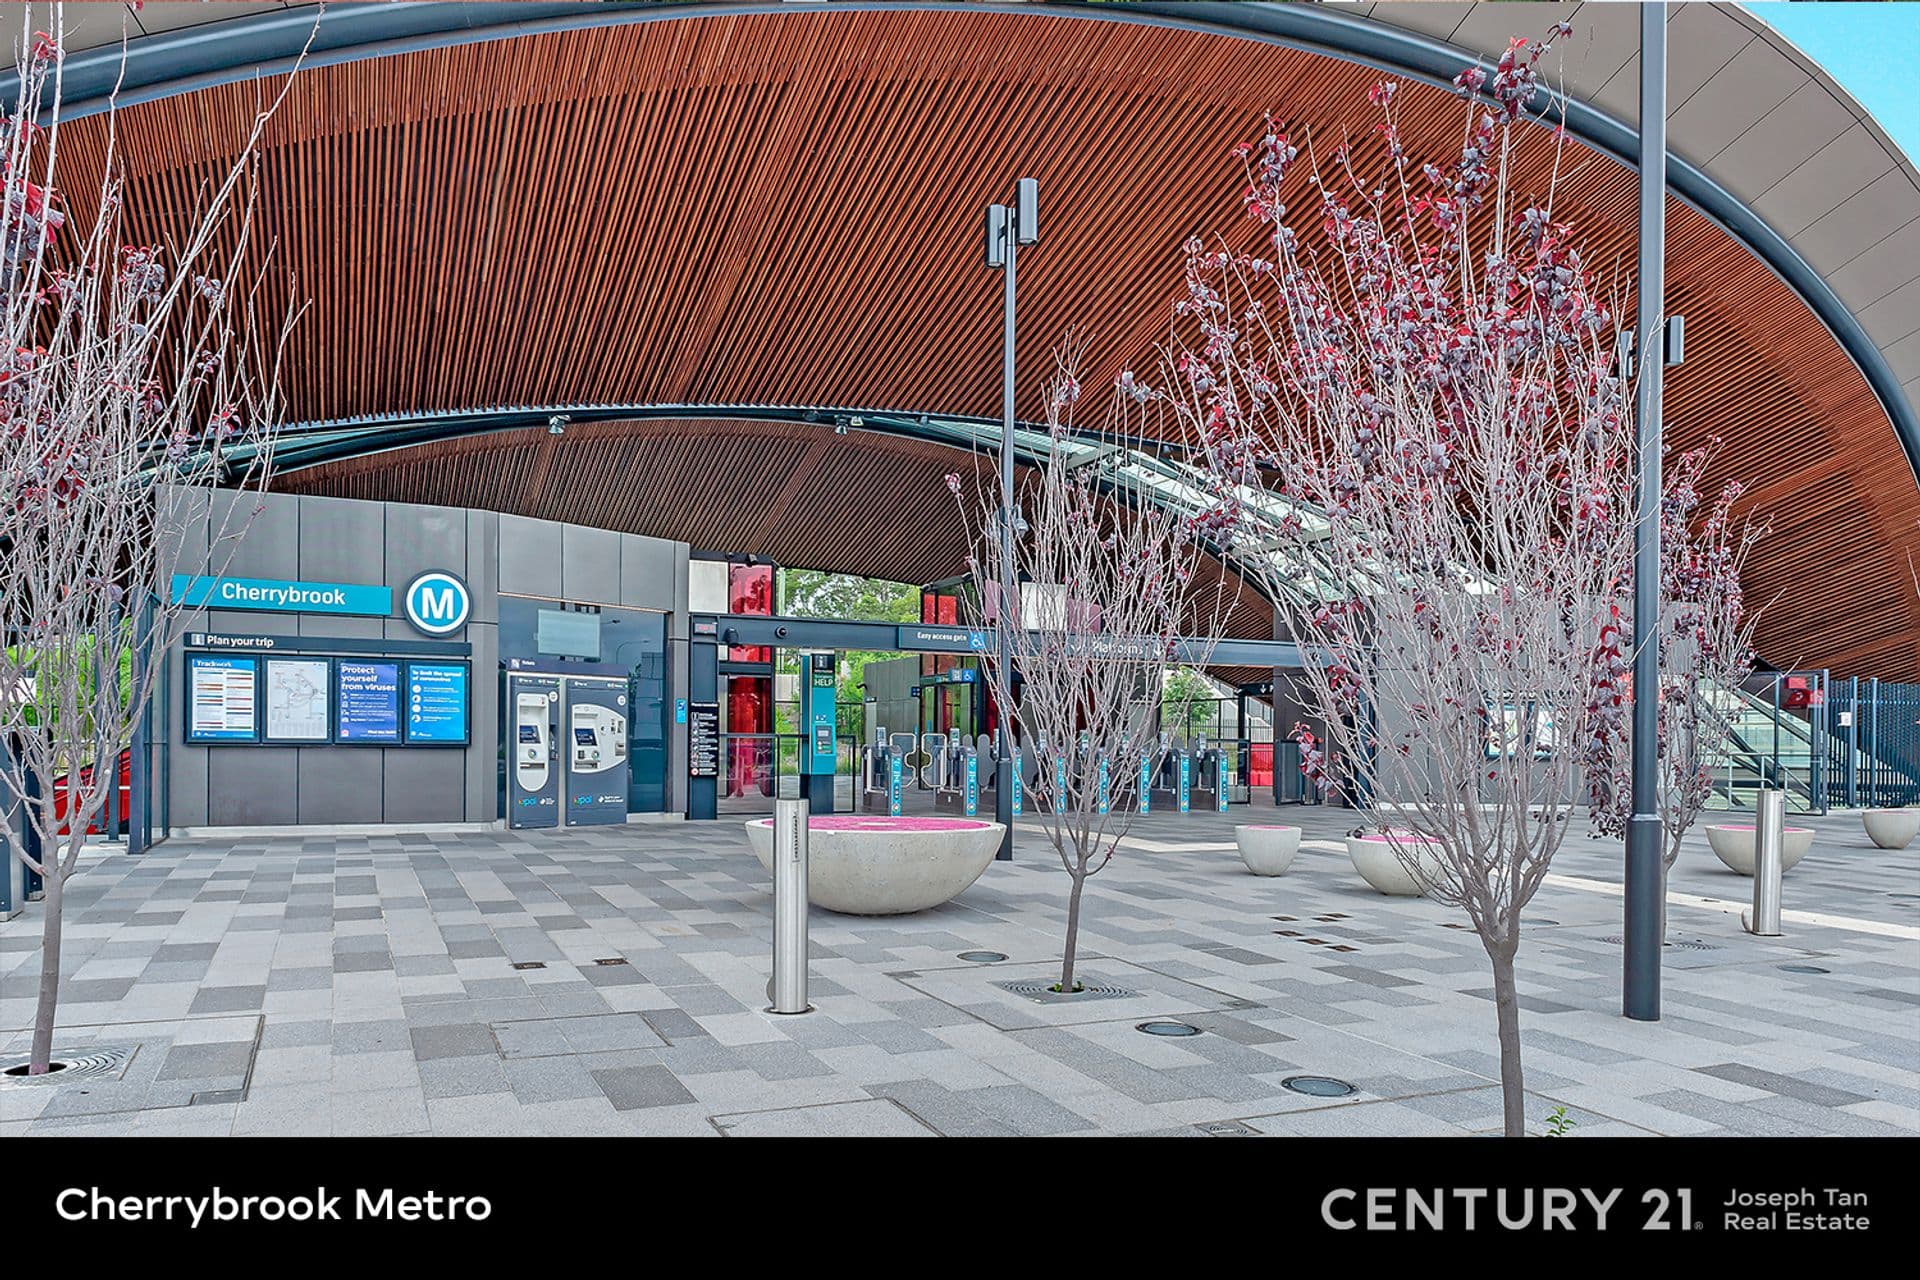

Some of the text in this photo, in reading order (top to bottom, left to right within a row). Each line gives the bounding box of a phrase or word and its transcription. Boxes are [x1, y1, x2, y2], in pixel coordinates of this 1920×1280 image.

[222, 582, 346, 606] Cherrybrook
[421, 587, 454, 620] M
[207, 635, 274, 648] Plan your trip
[917, 632, 931, 640] Easy
[953, 634, 967, 642] gate
[341, 666, 375, 674] Protect
[341, 675, 378, 683] yourself
[341, 683, 396, 692] from viruses
